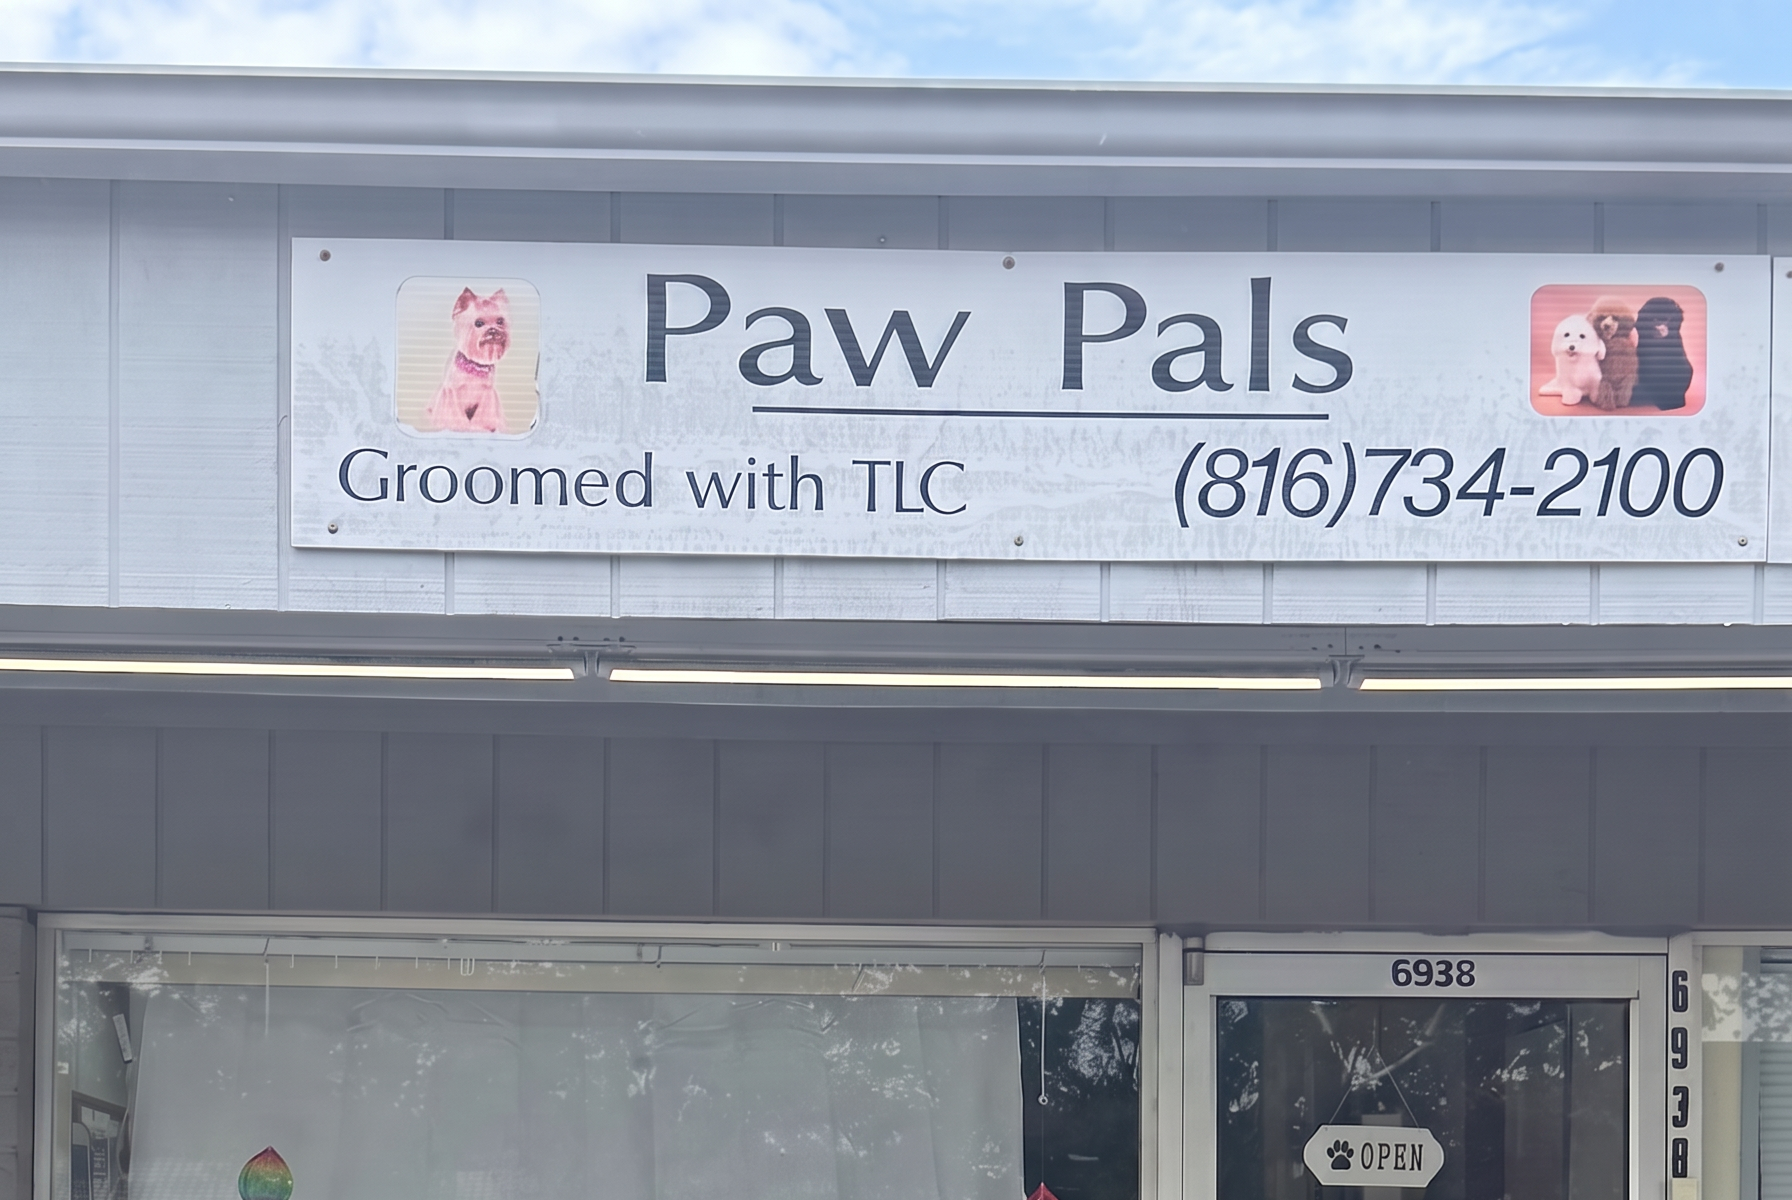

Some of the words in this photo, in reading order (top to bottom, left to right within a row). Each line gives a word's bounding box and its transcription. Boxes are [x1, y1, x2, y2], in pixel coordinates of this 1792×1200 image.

[646, 273, 972, 388] Paw
[1061, 276, 1354, 394] Pals
[338, 448, 654, 508] Groomed
[685, 455, 825, 511] with
[852, 459, 968, 515] TLC
[1174, 441, 1725, 528] (816)734-2100
[1391, 958, 1476, 988] 6938
[1671, 969, 1690, 1179] 6938
[1360, 1142, 1424, 1172] OPEN
